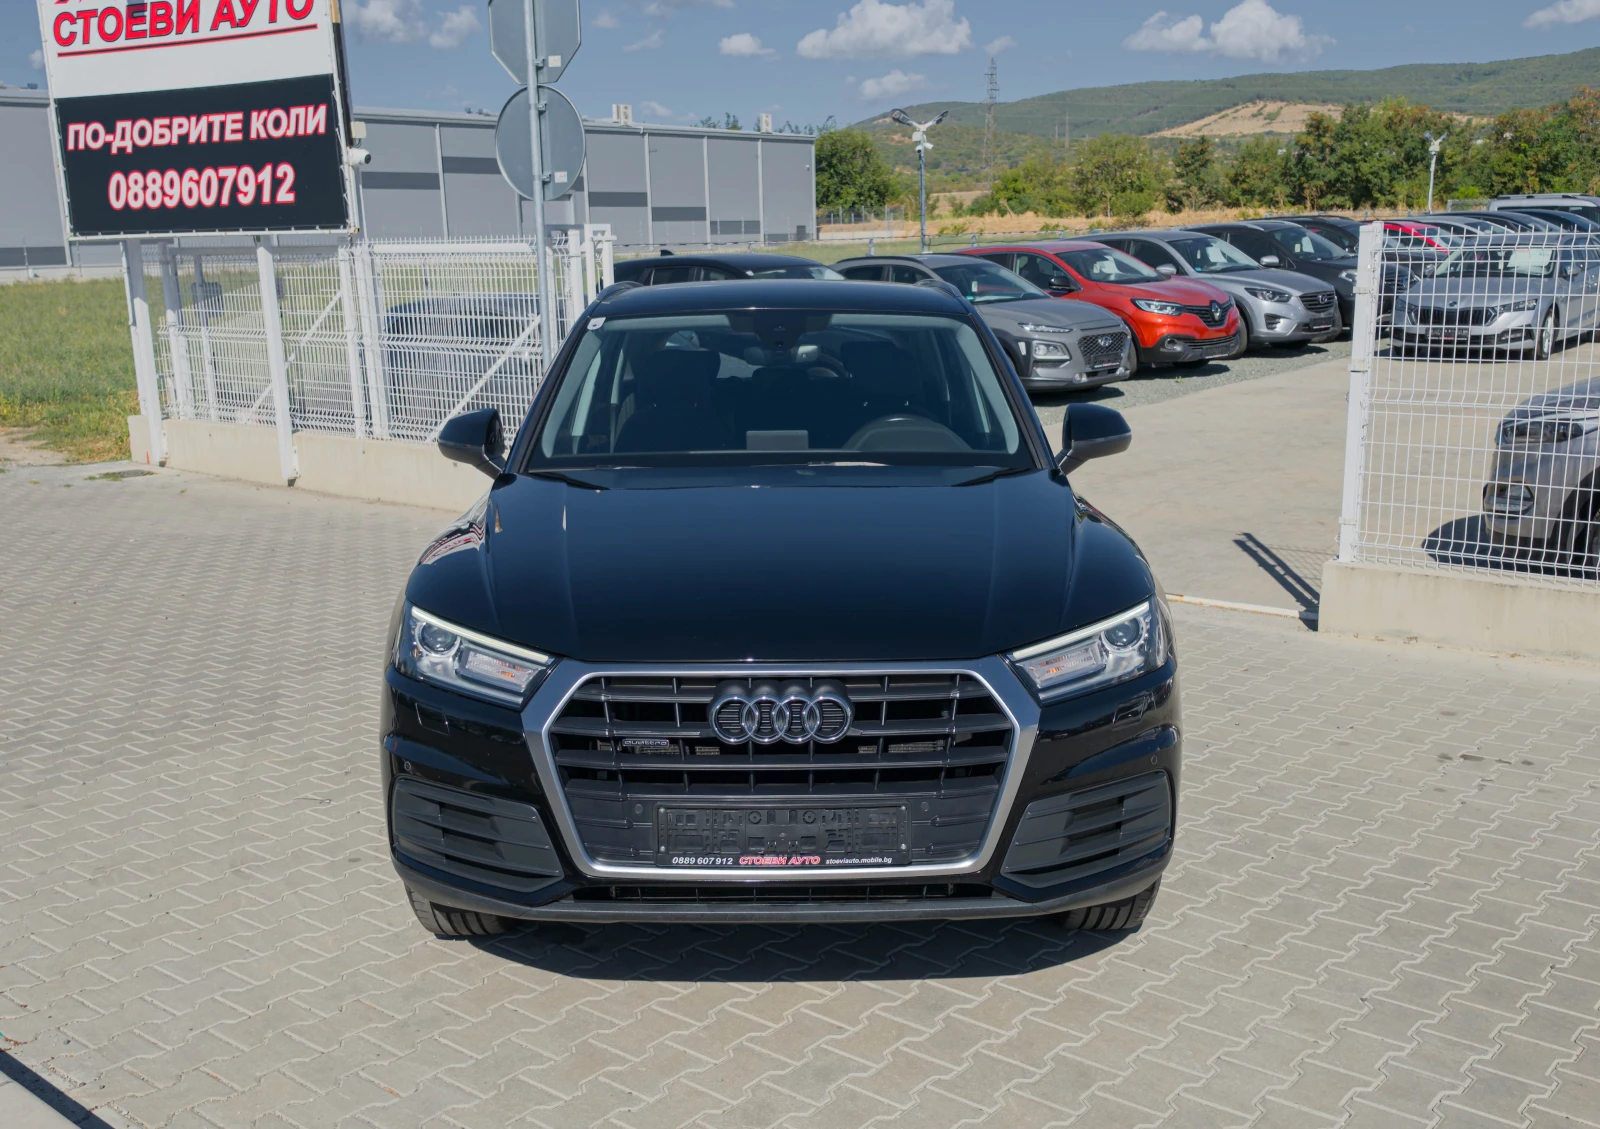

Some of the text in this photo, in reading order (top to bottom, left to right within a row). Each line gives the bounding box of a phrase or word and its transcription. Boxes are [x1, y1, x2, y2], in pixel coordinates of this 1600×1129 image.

[53, 0, 201, 47] СТОЕВИ
[67, 103, 328, 155] ПО-ДОБРИТЕ КОЛИ
[108, 162, 296, 211] 0889607912
[672, 856, 734, 865] 0889 607 912
[739, 855, 821, 866] СТОЕВИ АУТО
[825, 856, 893, 865] stoeviauto.mobile.bg
